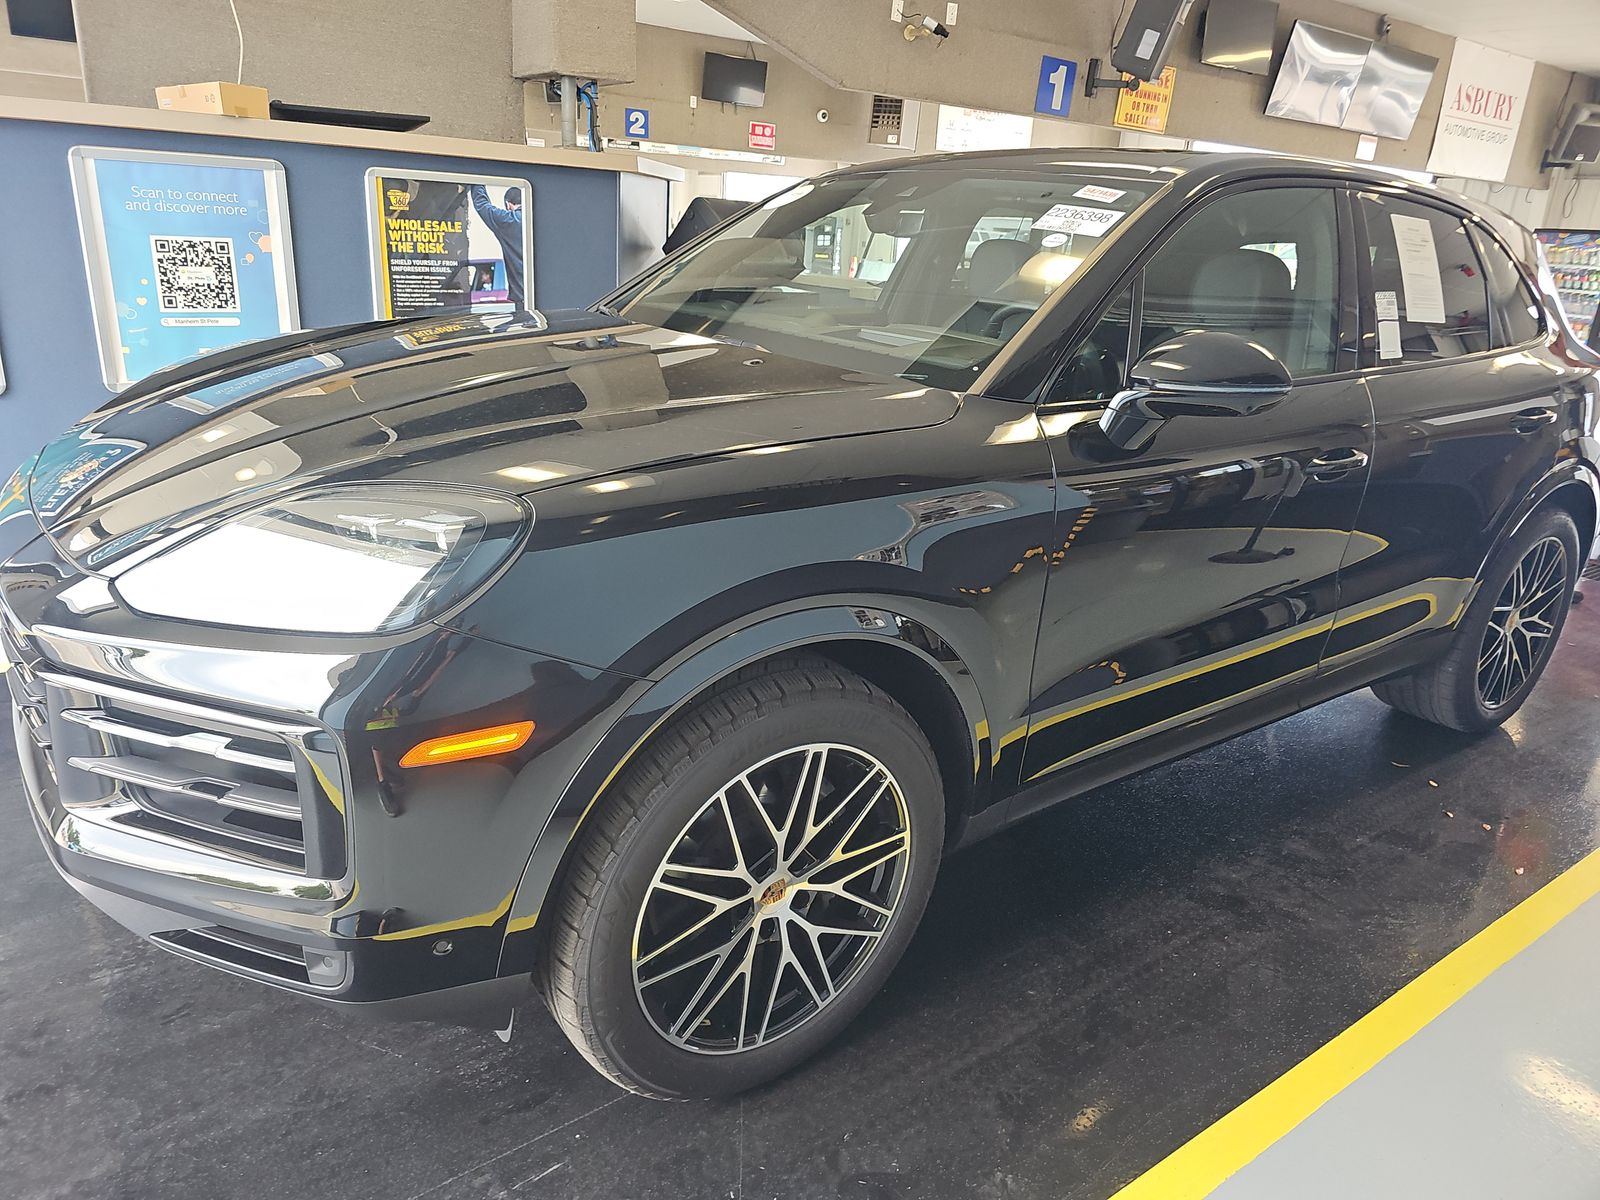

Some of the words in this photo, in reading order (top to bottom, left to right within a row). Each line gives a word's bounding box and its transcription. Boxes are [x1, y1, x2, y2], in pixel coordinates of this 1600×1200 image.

[1049, 65, 1068, 111] 1
[1135, 90, 1161, 102] RUNNING
[1161, 93, 1169, 103] IN
[1449, 83, 1518, 121] ASBURY
[1131, 101, 1140, 111] OR
[629, 111, 645, 135] 2
[1124, 112, 1140, 124] SALE
[131, 185, 164, 199] Scan
[168, 188, 182, 200] to
[186, 191, 240, 203] connect
[125, 199, 151, 211] and
[154, 199, 210, 214] discover
[213, 205, 248, 216] more
[1046, 207, 1114, 224] 2236398
[388, 219, 462, 232] WHOLESALE
[388, 230, 445, 242] WITHOUT
[390, 242, 414, 253] THE
[417, 243, 448, 254] RISK.
